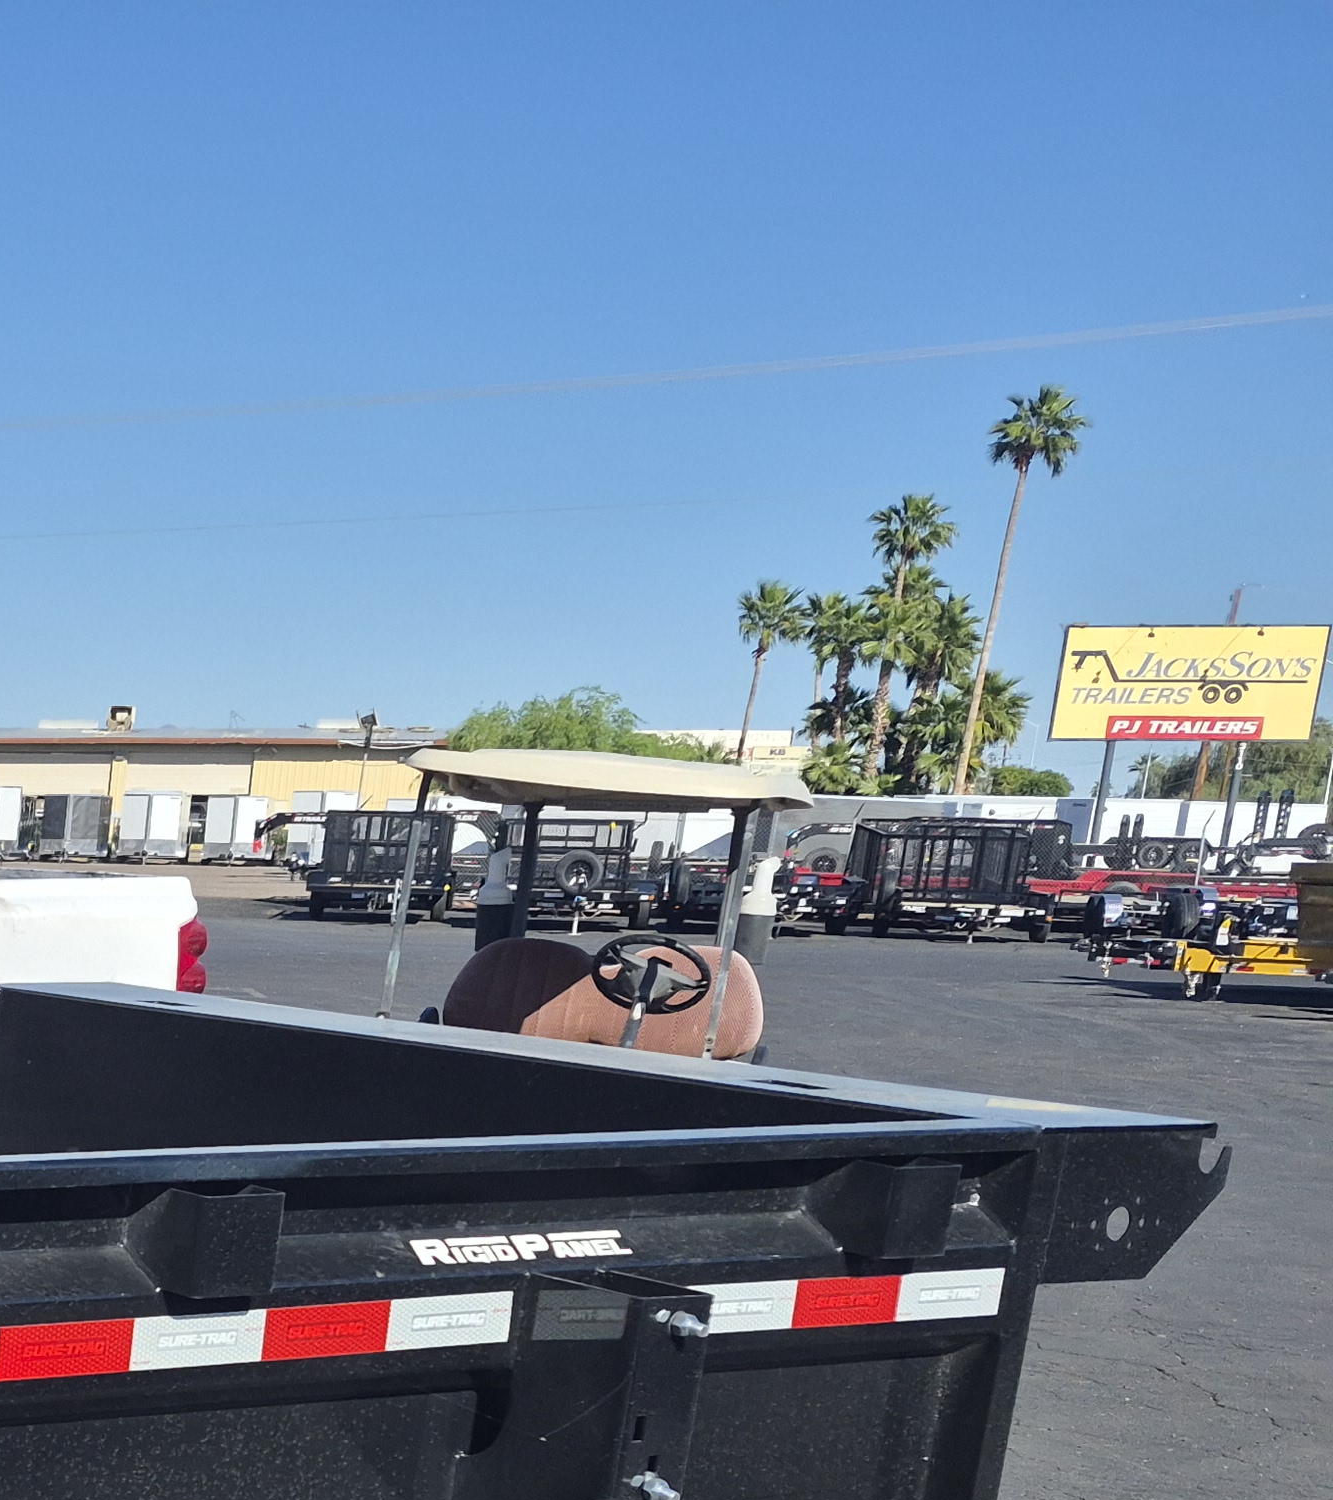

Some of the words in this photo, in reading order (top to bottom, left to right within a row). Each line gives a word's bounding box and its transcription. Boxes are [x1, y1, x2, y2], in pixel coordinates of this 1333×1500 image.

[1071, 687, 1193, 705] TRAILERS
[1110, 719, 1141, 734] PJ
[1148, 720, 1259, 734] TRAILERS
[919, 1284, 981, 1304] SURE-TRAC
[412, 1312, 485, 1329] SURE-TRAC
[24, 1338, 105, 1358] SURE-TRAC
[159, 1330, 237, 1348] SURE-TRAC
